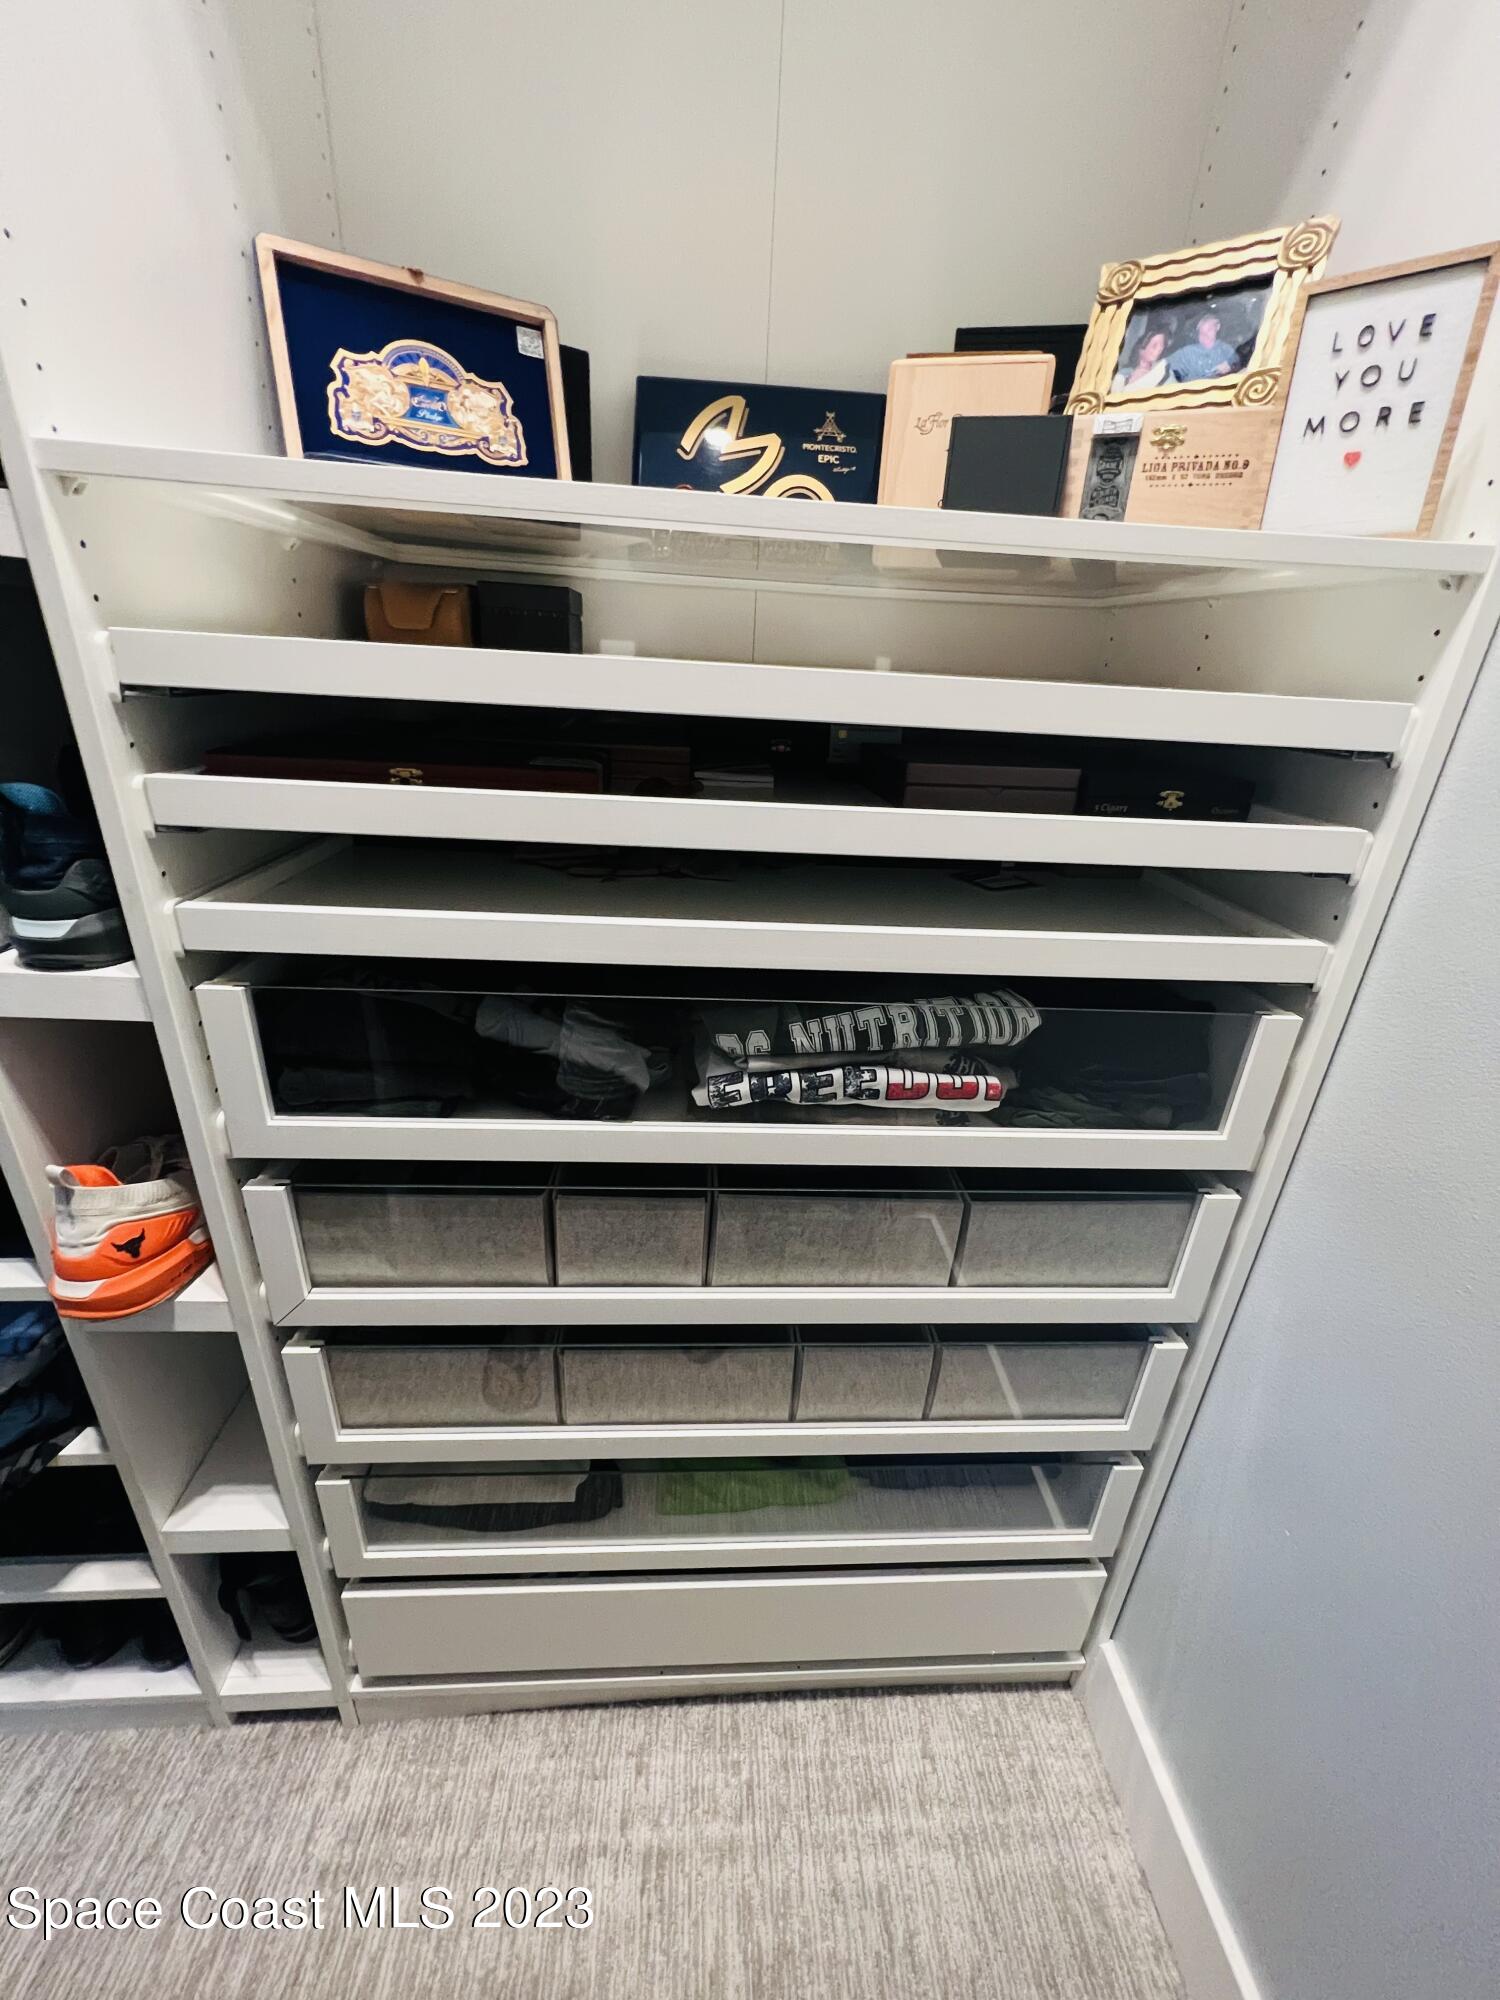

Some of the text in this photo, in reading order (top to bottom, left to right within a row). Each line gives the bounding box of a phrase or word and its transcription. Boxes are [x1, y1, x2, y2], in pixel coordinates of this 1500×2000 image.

[1332, 312, 1437, 353] LOVE
[1334, 357, 1418, 392] YOU
[1303, 400, 1427, 438] MORE
[817, 454, 840, 464] EPIC
[1170, 460, 1219, 473] PRIVADA
[788, 987, 1042, 1054] NUTRITION
